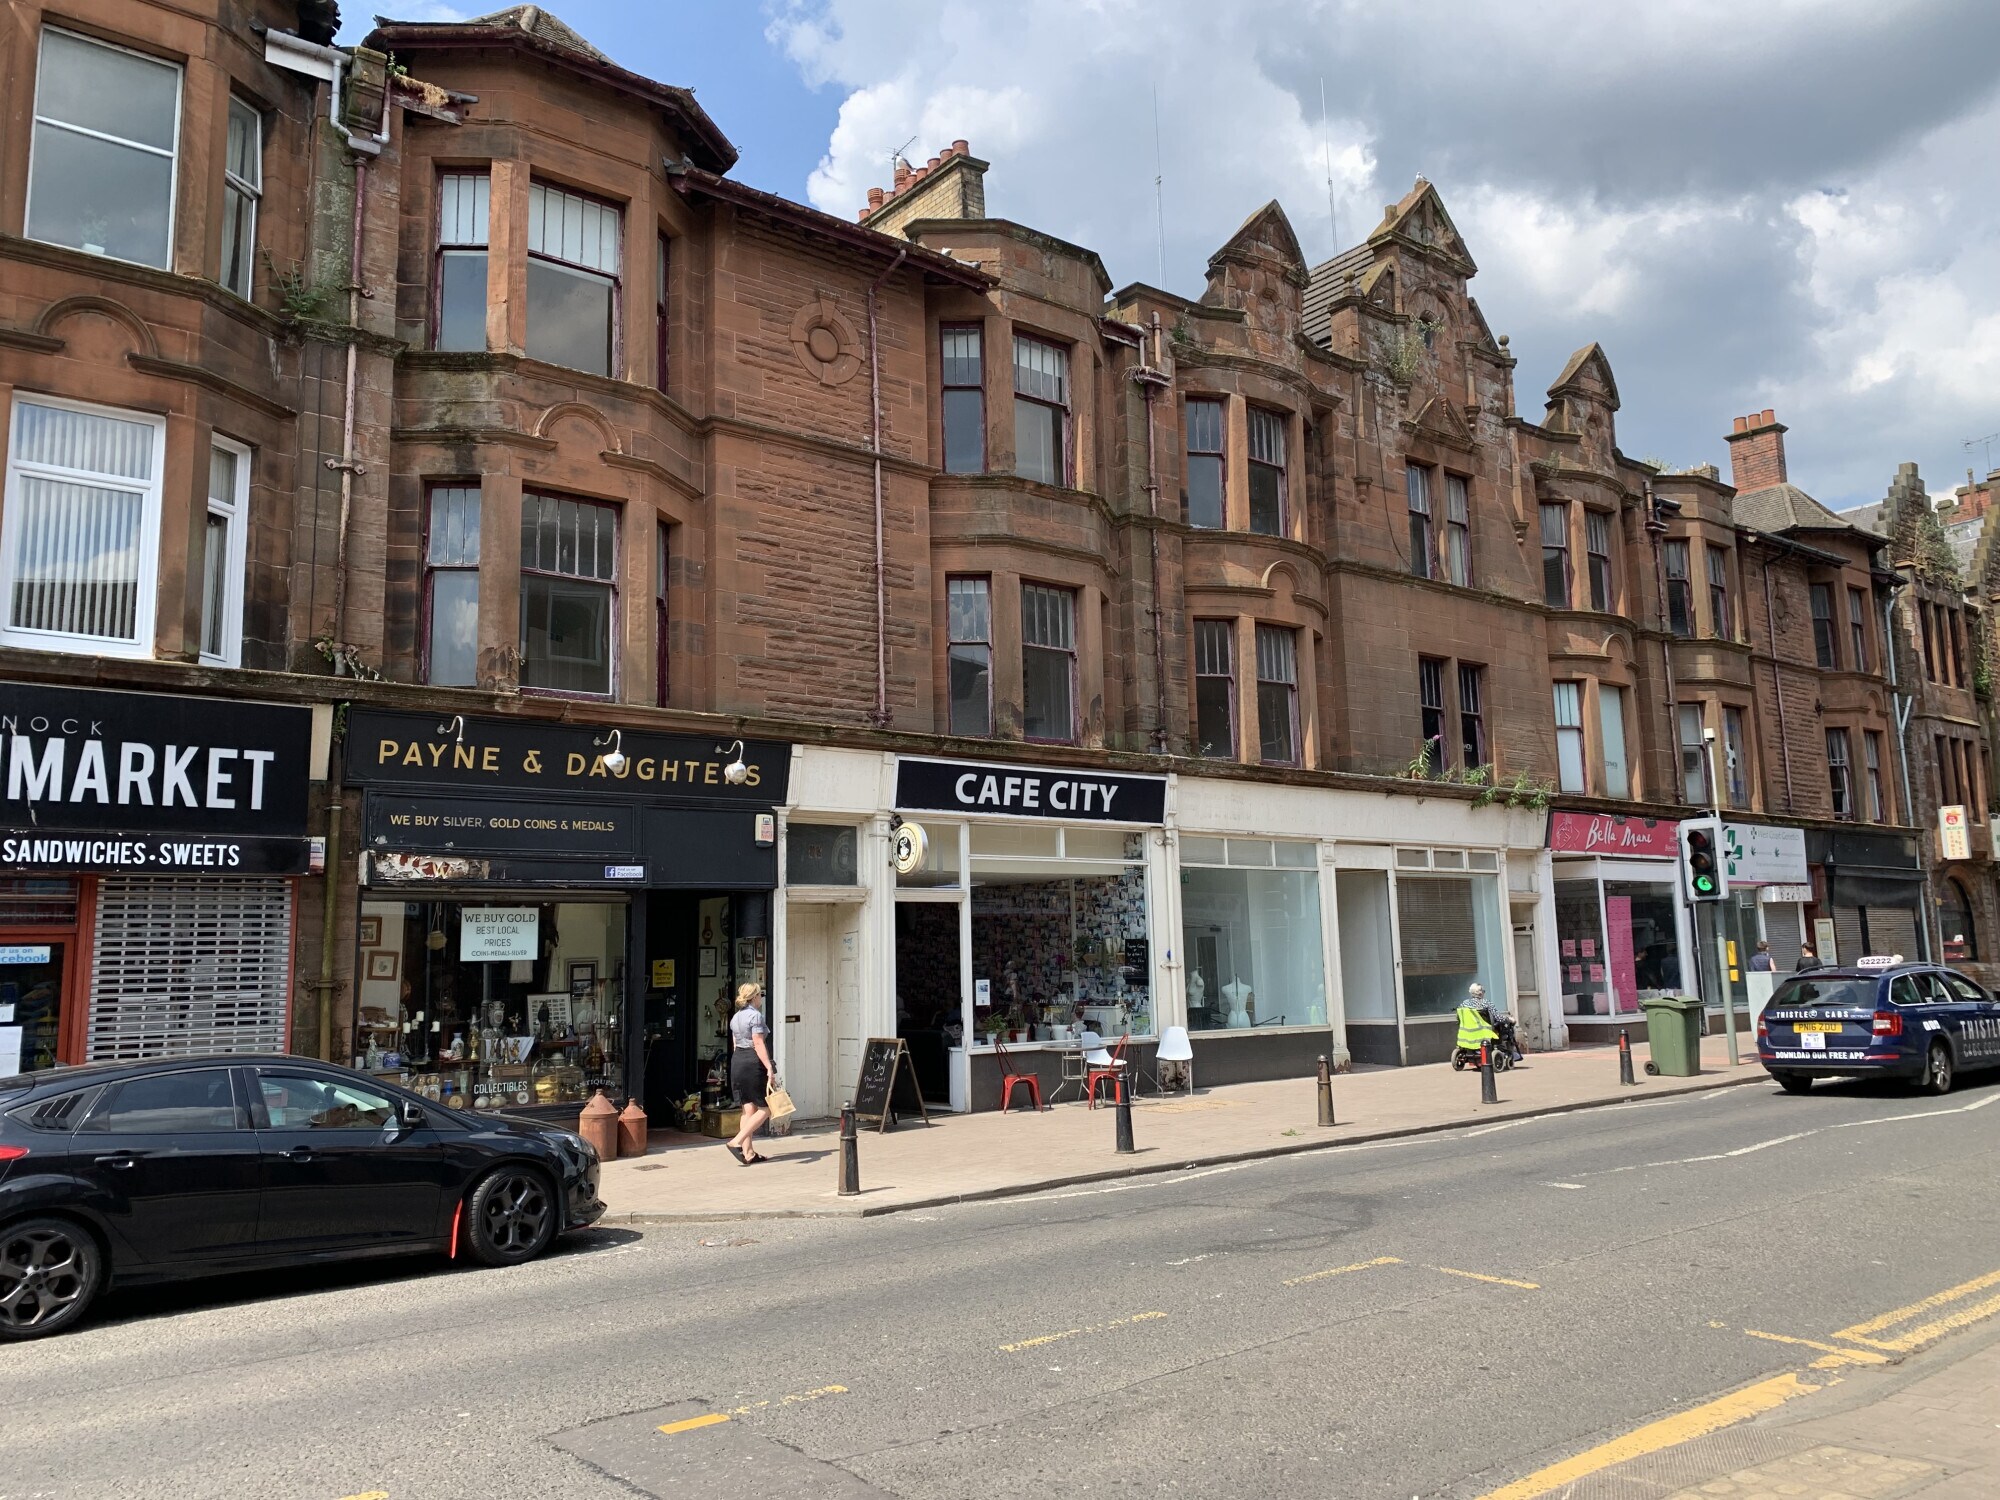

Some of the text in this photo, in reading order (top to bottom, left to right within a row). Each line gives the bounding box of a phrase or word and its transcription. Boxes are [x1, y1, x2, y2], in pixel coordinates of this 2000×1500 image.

[378, 740, 761, 786] PAYNE & DAUGHTES
[0, 734, 275, 811] MARKET
[955, 773, 1119, 813] CAFE CITY
[390, 815, 615, 832] WE BUY SILVER, GOLD COINS & MEDALS
[1585, 817, 1617, 850] Bella
[2, 839, 240, 867] SANDWICHES SWEETS
[464, 913, 536, 923] WE BUY GOLD
[476, 925, 520, 935] BEST LOCAL
[484, 938, 512, 947] PRICES
[1860, 957, 1892, 966] 522222
[1776, 1010, 1809, 1019] THISTLE
[1824, 1010, 1849, 1019] CABS
[1775, 1051, 1865, 1060] DOWNLOAD OUR FREE APP
[474, 1081, 528, 1095] COLLECTIBLES
[573, 1078, 616, 1091] ANTIQUES
